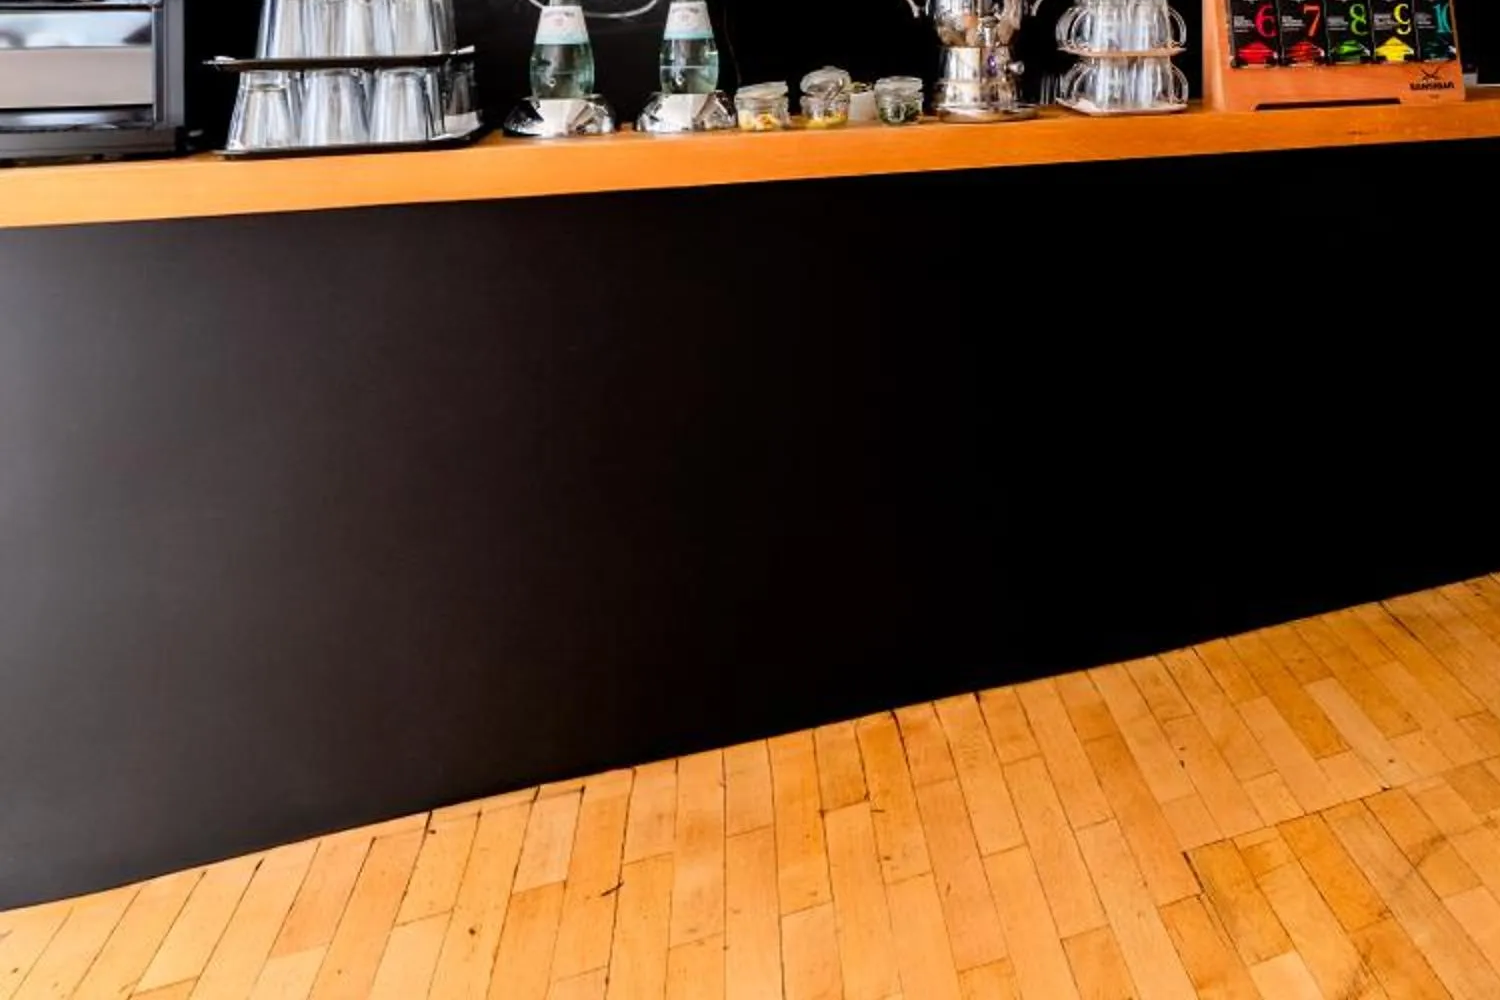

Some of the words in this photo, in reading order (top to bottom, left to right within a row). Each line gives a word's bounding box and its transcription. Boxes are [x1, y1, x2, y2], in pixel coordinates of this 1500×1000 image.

[1255, 4, 1277, 38] 6
[1303, 4, 1320, 37] 7
[1349, 3, 1368, 36] 8
[1393, 3, 1412, 35] 9
